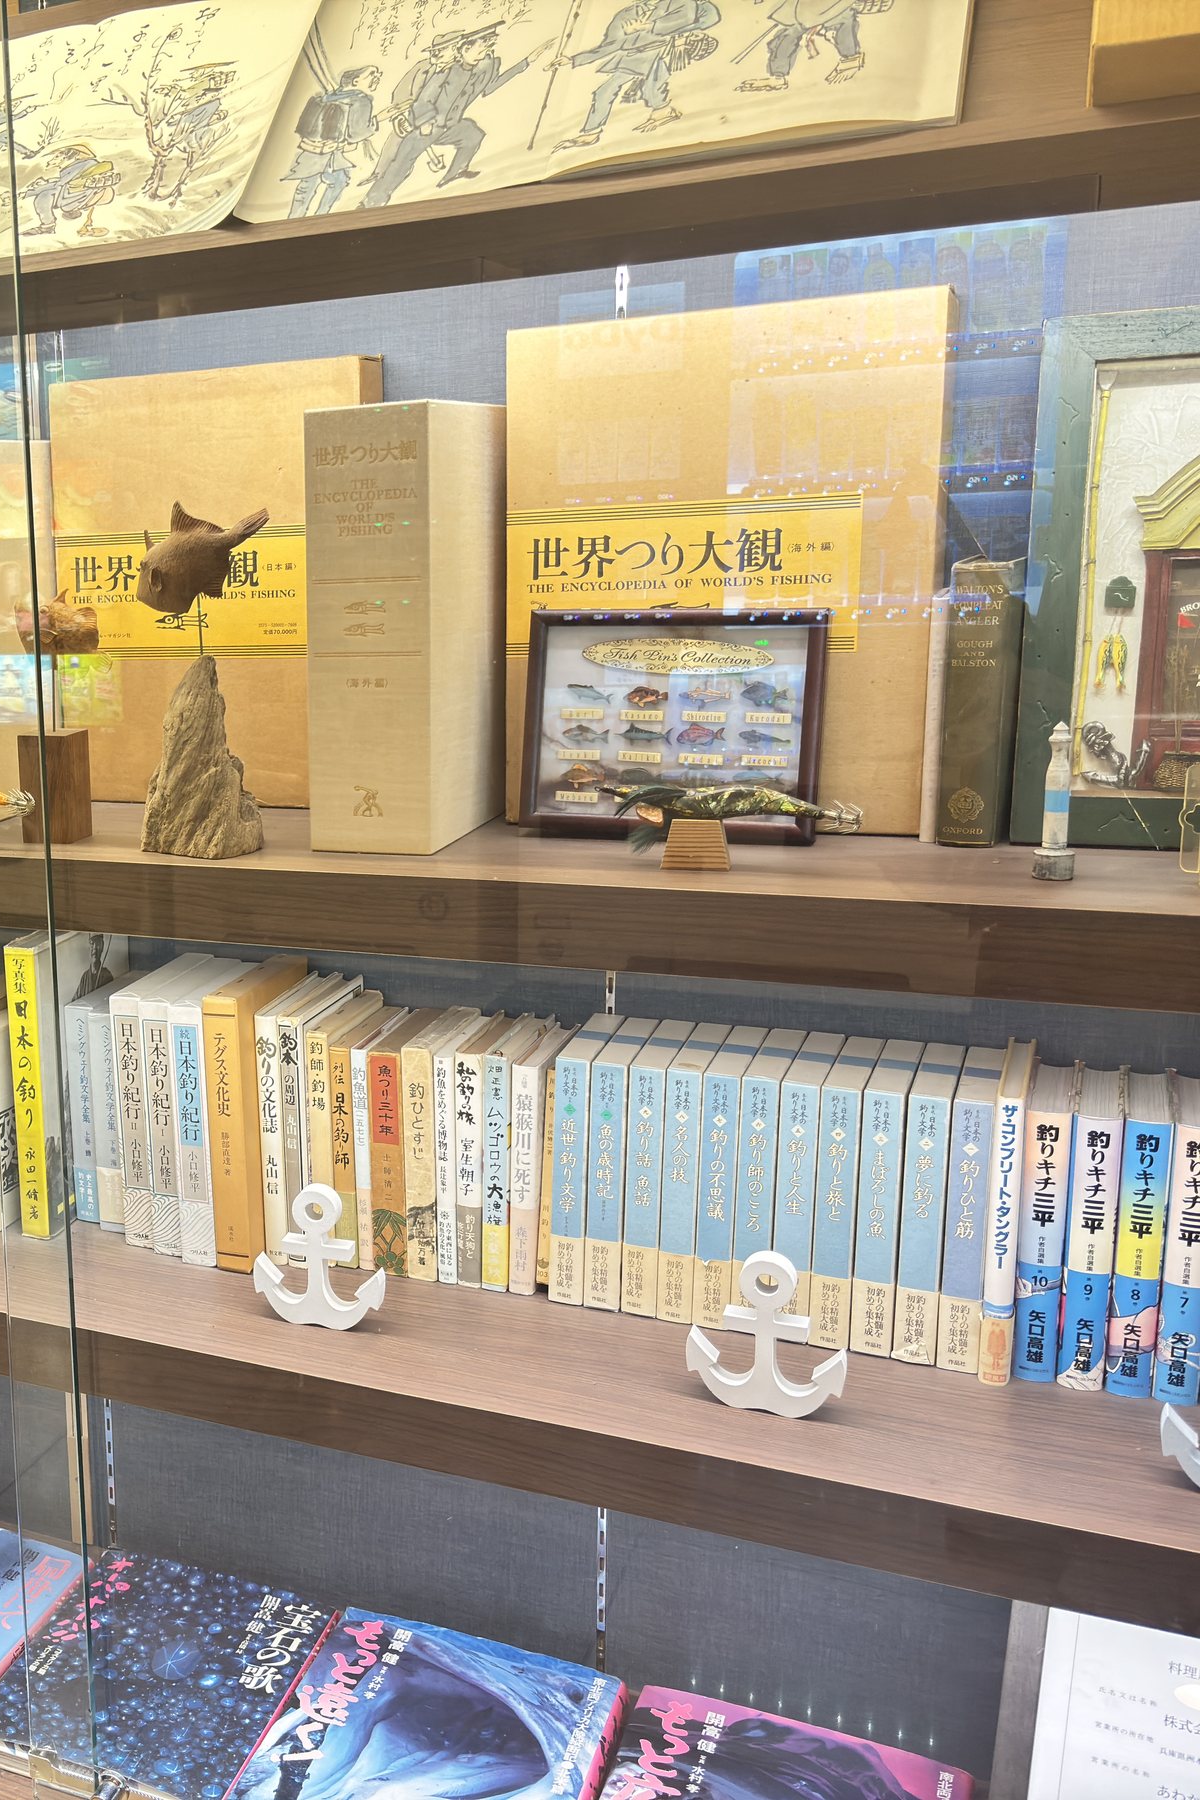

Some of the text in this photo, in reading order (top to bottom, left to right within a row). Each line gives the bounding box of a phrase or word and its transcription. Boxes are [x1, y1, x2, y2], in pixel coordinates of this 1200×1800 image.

[313, 488, 418, 504] ENCYCLOPEDIA
[352, 479, 378, 490] THE
[356, 503, 373, 513] OF
[336, 513, 395, 525] WORLD'S
[337, 524, 393, 537] FISHING
[527, 527, 783, 581] 世界つり大観
[72, 590, 296, 604] THE FISHING
[527, 573, 833, 594] THE ENCYCLOPEDIA OF WORLD'S FISHING
[953, 599, 1003, 611] COMPLEAT
[956, 583, 1003, 597] WALTON'S
[955, 615, 1000, 627] ANGLER
[603, 648, 751, 665] Fish Pin's Collection
[952, 657, 996, 668] BALSTON
[957, 640, 993, 650] GOUGH
[943, 826, 983, 835] OXFORD
[12, 958, 27, 994] 写真集
[14, 1000, 37, 1130] 日本の釣り
[77, 1017, 91, 1124] ヘミングウェイ釣文学全集
[102, 1024, 116, 1131] ヘミングウェイ釣文学全集
[120, 1022, 141, 1119] 日本釣り紀行
[149, 1028, 170, 1126] 日本釣り紀行
[178, 1029, 199, 1142] 続日本釣り紀行
[213, 1033, 230, 1117] テグス文化史
[255, 1038, 278, 1134] 釣りの文化誌
[310, 1042, 325, 1111] 釣師・釣場
[352, 1067, 367, 1110] 釣魚道
[488, 1066, 502, 1100] 畑正憲
[600, 1072, 608, 1101] 釣り文学
[332, 1062, 349, 1170] 列伝 日本の釣り師
[378, 1065, 393, 1136] 魚つり三十年
[437, 1068, 448, 1162] 釣魚をめぐる博物誌
[456, 1062, 476, 1125] 私の釣りの旅
[286, 1115, 297, 1149] 丸山信
[409, 1083, 424, 1160] 釣ひとすじ
[131, 1140, 143, 1182] 小口修平
[159, 1147, 172, 1188] 小口修平
[188, 1151, 200, 1192] 小口修平
[459, 1138, 474, 1196] 室生朝子
[514, 1094, 533, 1204] 猿猴川に死す
[560, 1119, 578, 1212] 近世・釣り文学
[596, 1124, 613, 1199] 魚の歳時記
[635, 1121, 653, 1207] 釣り話 魚話
[670, 1126, 690, 1184] 名人の技
[266, 1155, 278, 1195] 丸山信
[707, 1129, 728, 1221] 釣りの不思議
[747, 1134, 766, 1232] 釣り師のこころ
[785, 1140, 806, 1216] 釣りと人生
[825, 1143, 847, 1221] 釣りと旅と
[867, 1150, 890, 1239] まぼろしの魚
[914, 1155, 933, 1218] 夢に釣る
[994, 1104, 1018, 1269] ザ・コンプリート・タングラー
[1031, 1124, 1060, 1227] 釣りキチ三平
[1081, 1130, 1111, 1234] 釣りキチ三平
[1130, 1134, 1161, 1239] 釣りキチ三平
[955, 1160, 979, 1239] 釣りひと筋
[465, 1215, 476, 1258] 釣り天狗と
[515, 1227, 528, 1272] 森下雨村
[1037, 1236, 1046, 1264] 作者自選集
[1086, 1244, 1095, 1272] 作者自選集
[556, 1241, 565, 1288] 初めて集大成
[565, 1241, 574, 1289] 釣りの精髄を
[591, 1246, 600, 1292] 初めて集大成
[599, 1246, 608, 1293] 釣りの精髄を
[626, 1250, 635, 1297] 初めて集大成
[634, 1251, 644, 1298] 釣りの精髄を
[1032, 1276, 1048, 1287] 10
[1134, 1248, 1143, 1277] 作者自選集
[1084, 1285, 1093, 1296] 9
[1131, 1289, 1141, 1301] 8
[1179, 1297, 1190, 1308] 7
[1026, 1310, 1047, 1363] 矢口高雄
[1074, 1318, 1094, 1372] 矢口高雄
[1121, 1323, 1142, 1378] 矢口高雄
[1167, 1332, 1190, 1388] 矢口高雄
[239, 1604, 320, 1694] 宝石の歌
[381, 1629, 413, 1666] 開高健
[1168, 1661, 1200, 1680] 料理
[270, 1619, 385, 1763] もっと遠く!
[696, 1711, 727, 1754] 開高健
[1095, 1721, 1154, 1743] 営業所の所在地
